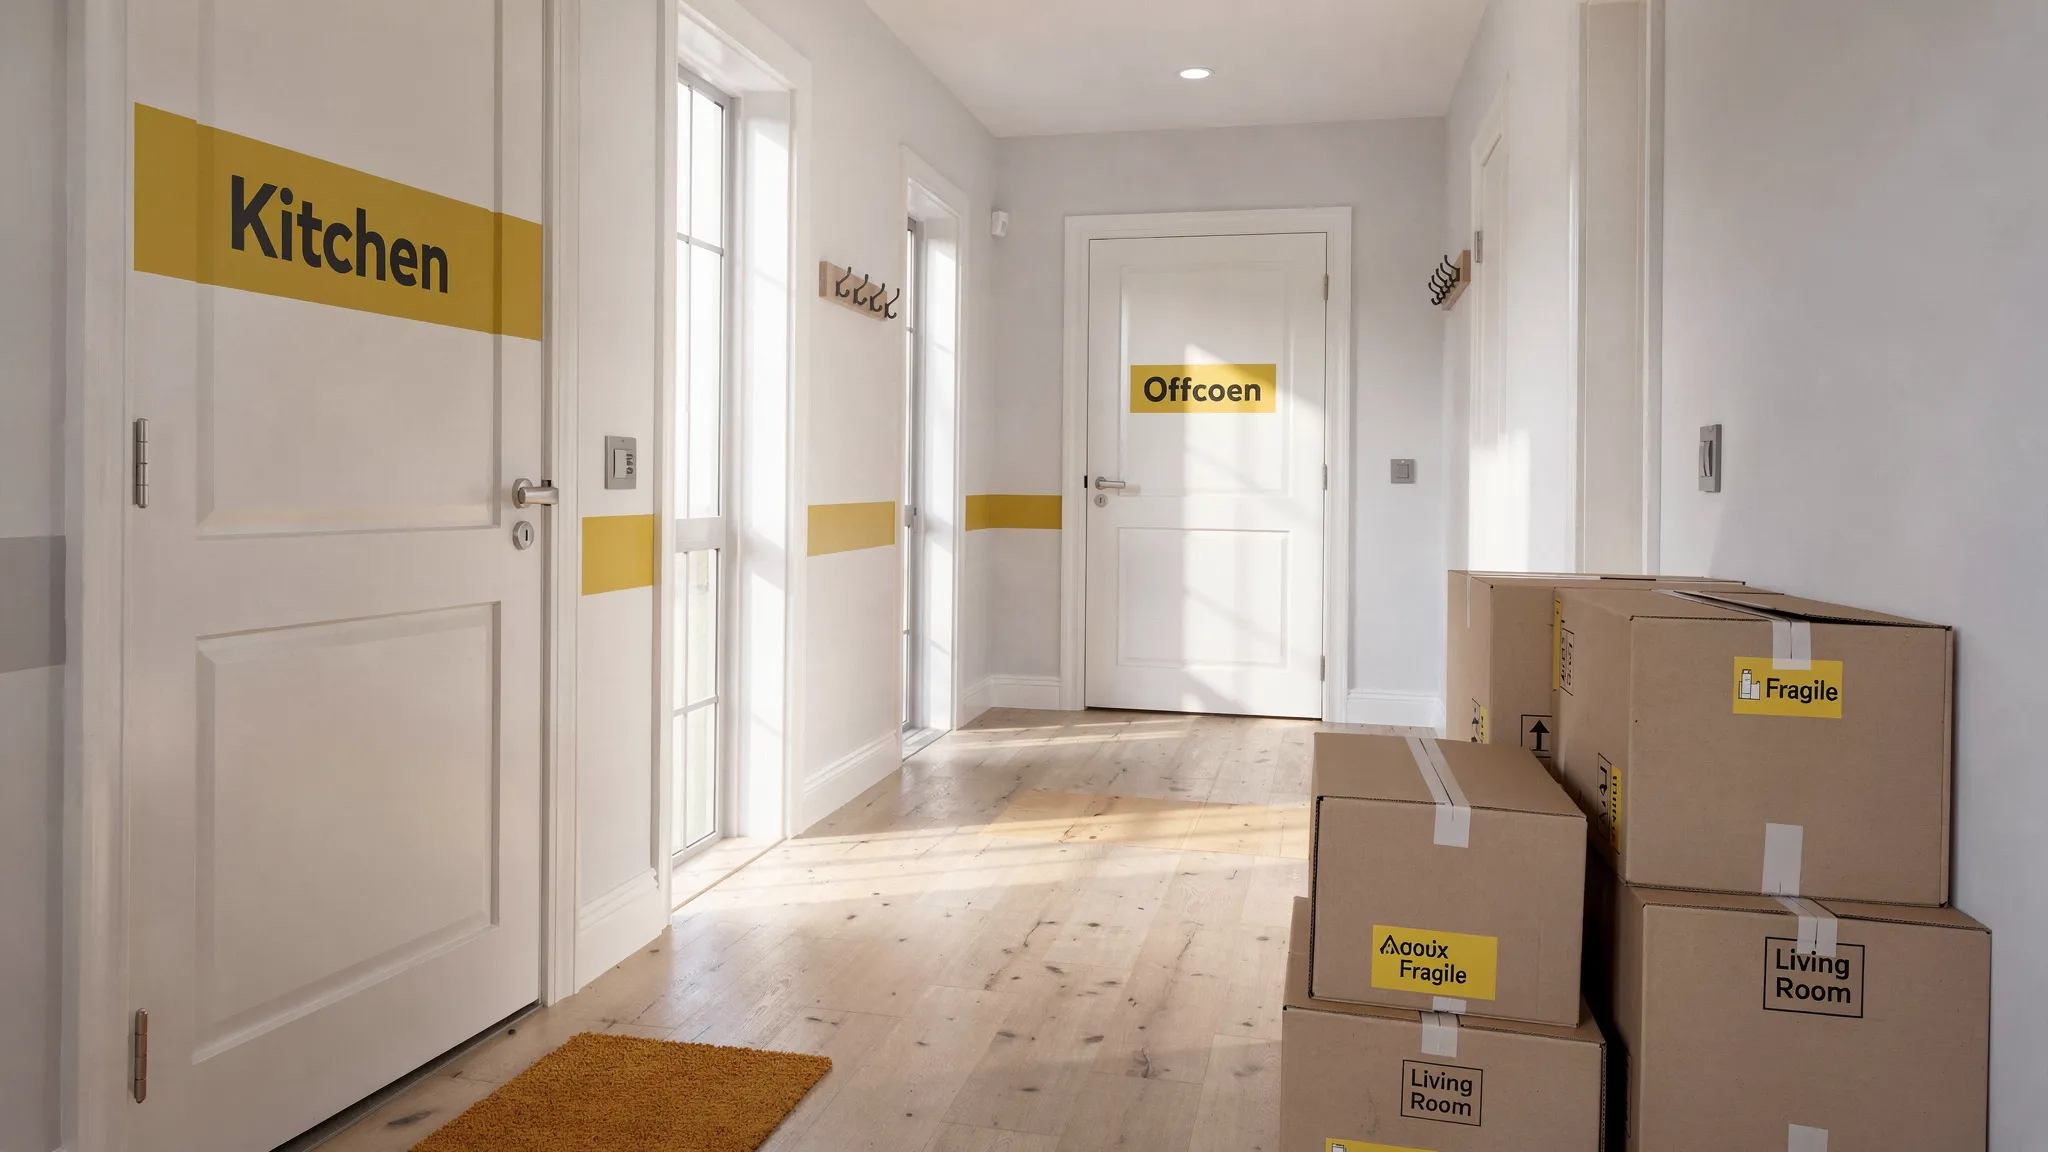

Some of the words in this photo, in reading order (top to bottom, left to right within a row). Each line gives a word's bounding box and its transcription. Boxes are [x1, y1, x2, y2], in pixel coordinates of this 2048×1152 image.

[230, 175, 449, 294] Kitchen
[1143, 376, 1261, 402] Offcoen
[1766, 677, 1838, 704] Fragile
[1400, 959, 1467, 986] Fragile
[1776, 948, 1850, 980] Living
[1776, 976, 1851, 1004] Room
[1411, 1068, 1473, 1097] Living
[1411, 1091, 1472, 1117] Room
